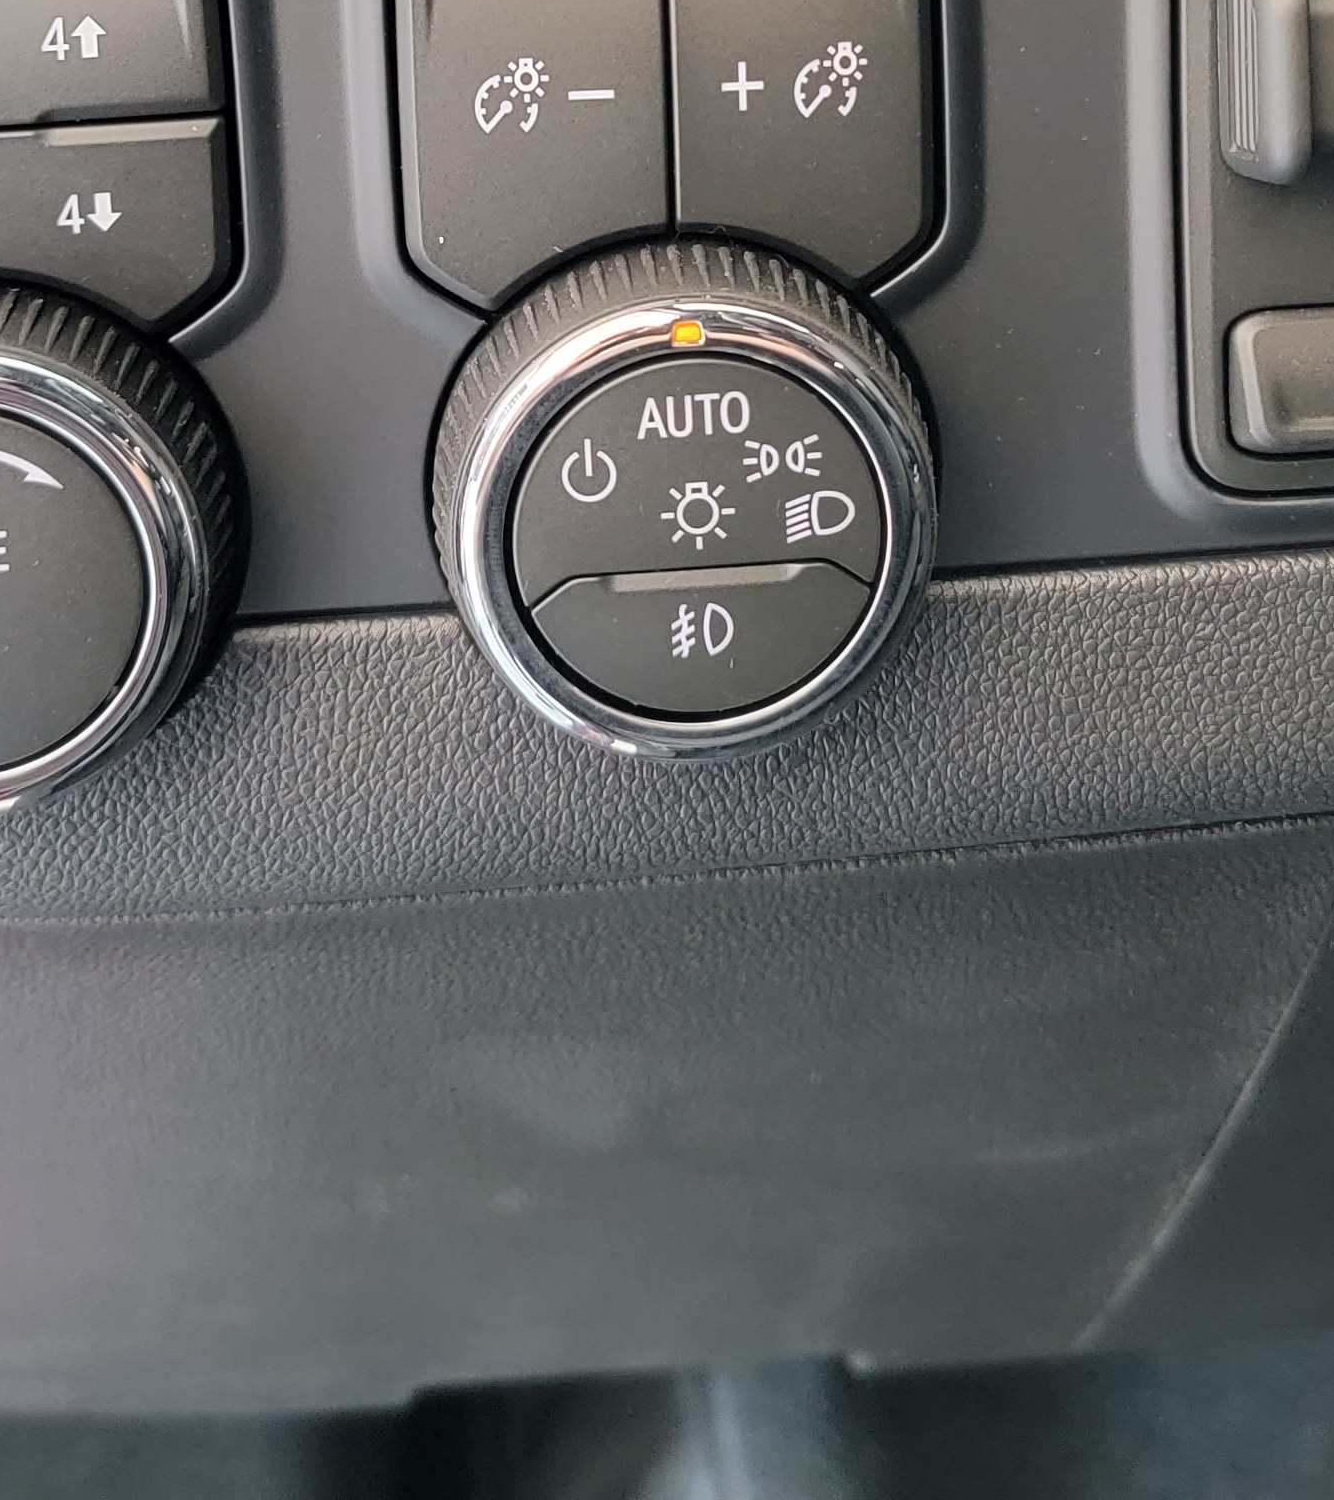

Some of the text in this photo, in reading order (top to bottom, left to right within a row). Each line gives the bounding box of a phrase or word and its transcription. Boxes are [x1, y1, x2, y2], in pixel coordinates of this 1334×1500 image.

[41, 17, 70, 61] 4
[57, 193, 85, 234] 4
[637, 390, 750, 440] AUTO
